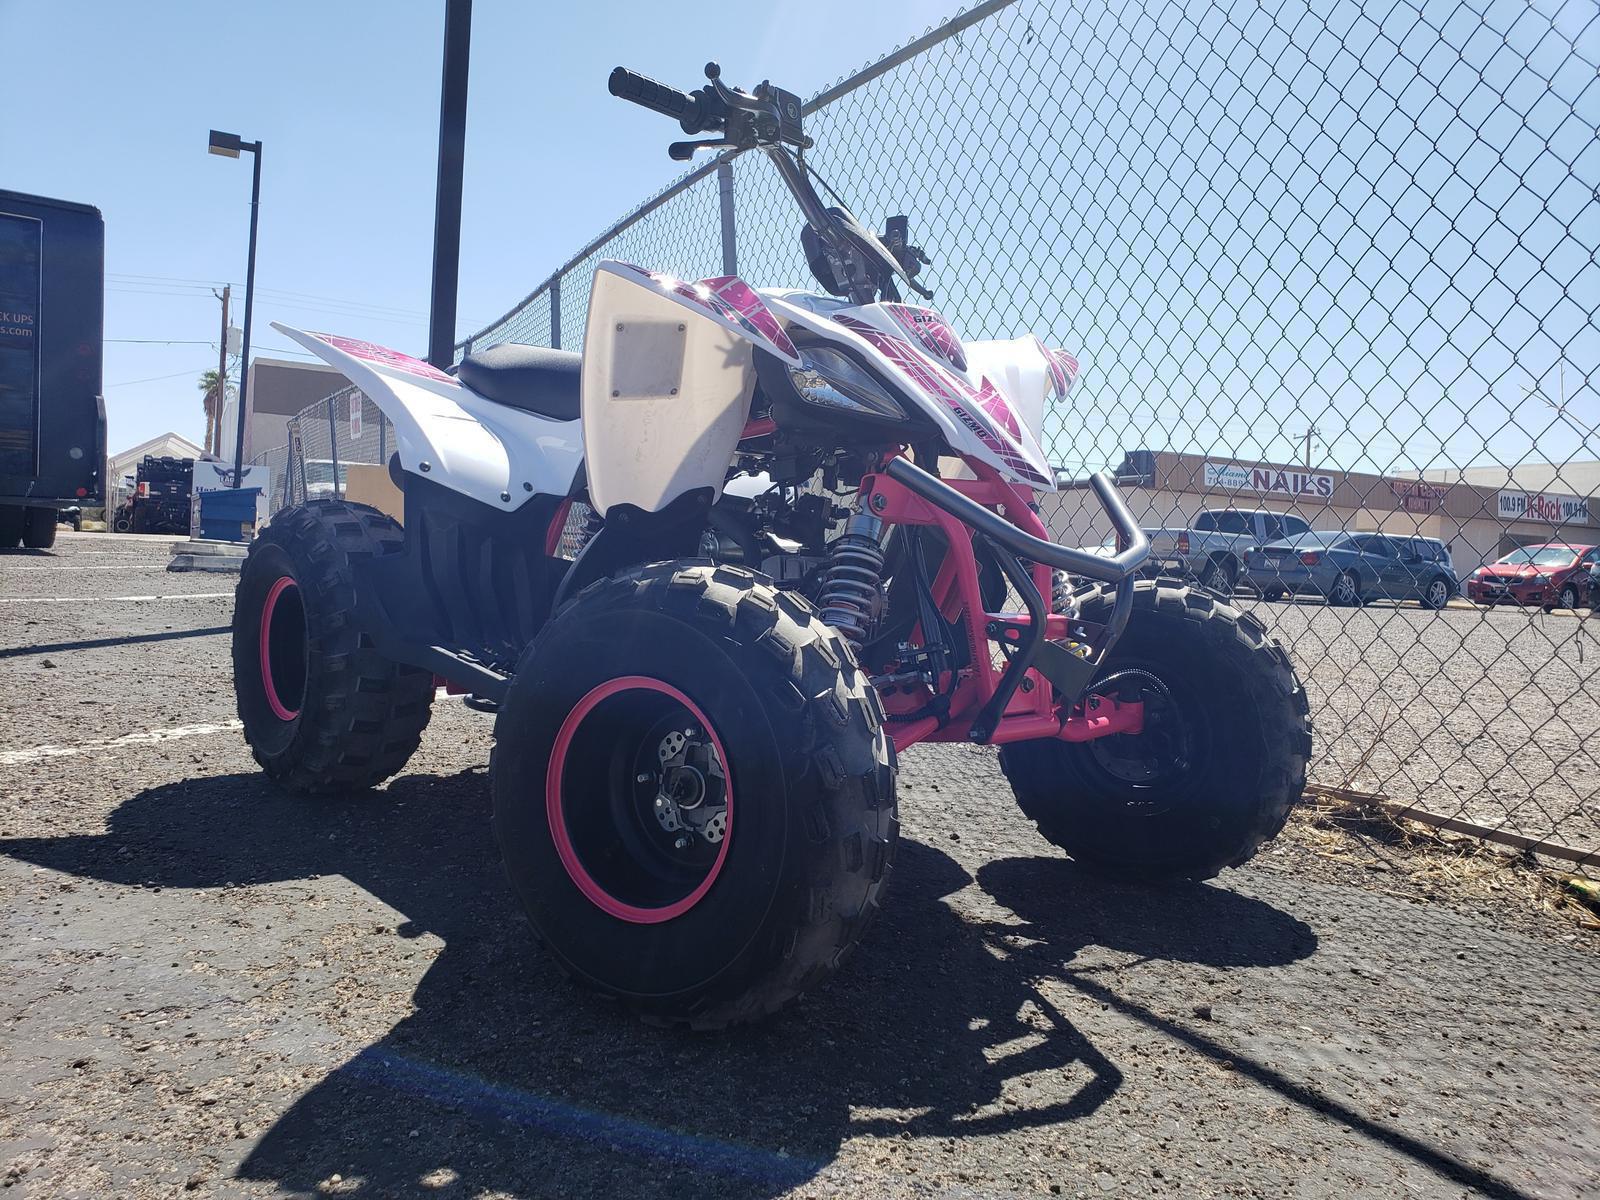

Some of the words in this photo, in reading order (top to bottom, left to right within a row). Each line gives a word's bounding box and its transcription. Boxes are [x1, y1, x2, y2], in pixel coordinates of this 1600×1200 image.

[13, 313, 33, 324] UPS
[953, 406, 988, 438] GIZMO
[1253, 469, 1331, 497] NAILS
[1500, 495, 1515, 512] 100.9
[1516, 498, 1526, 513] FM
